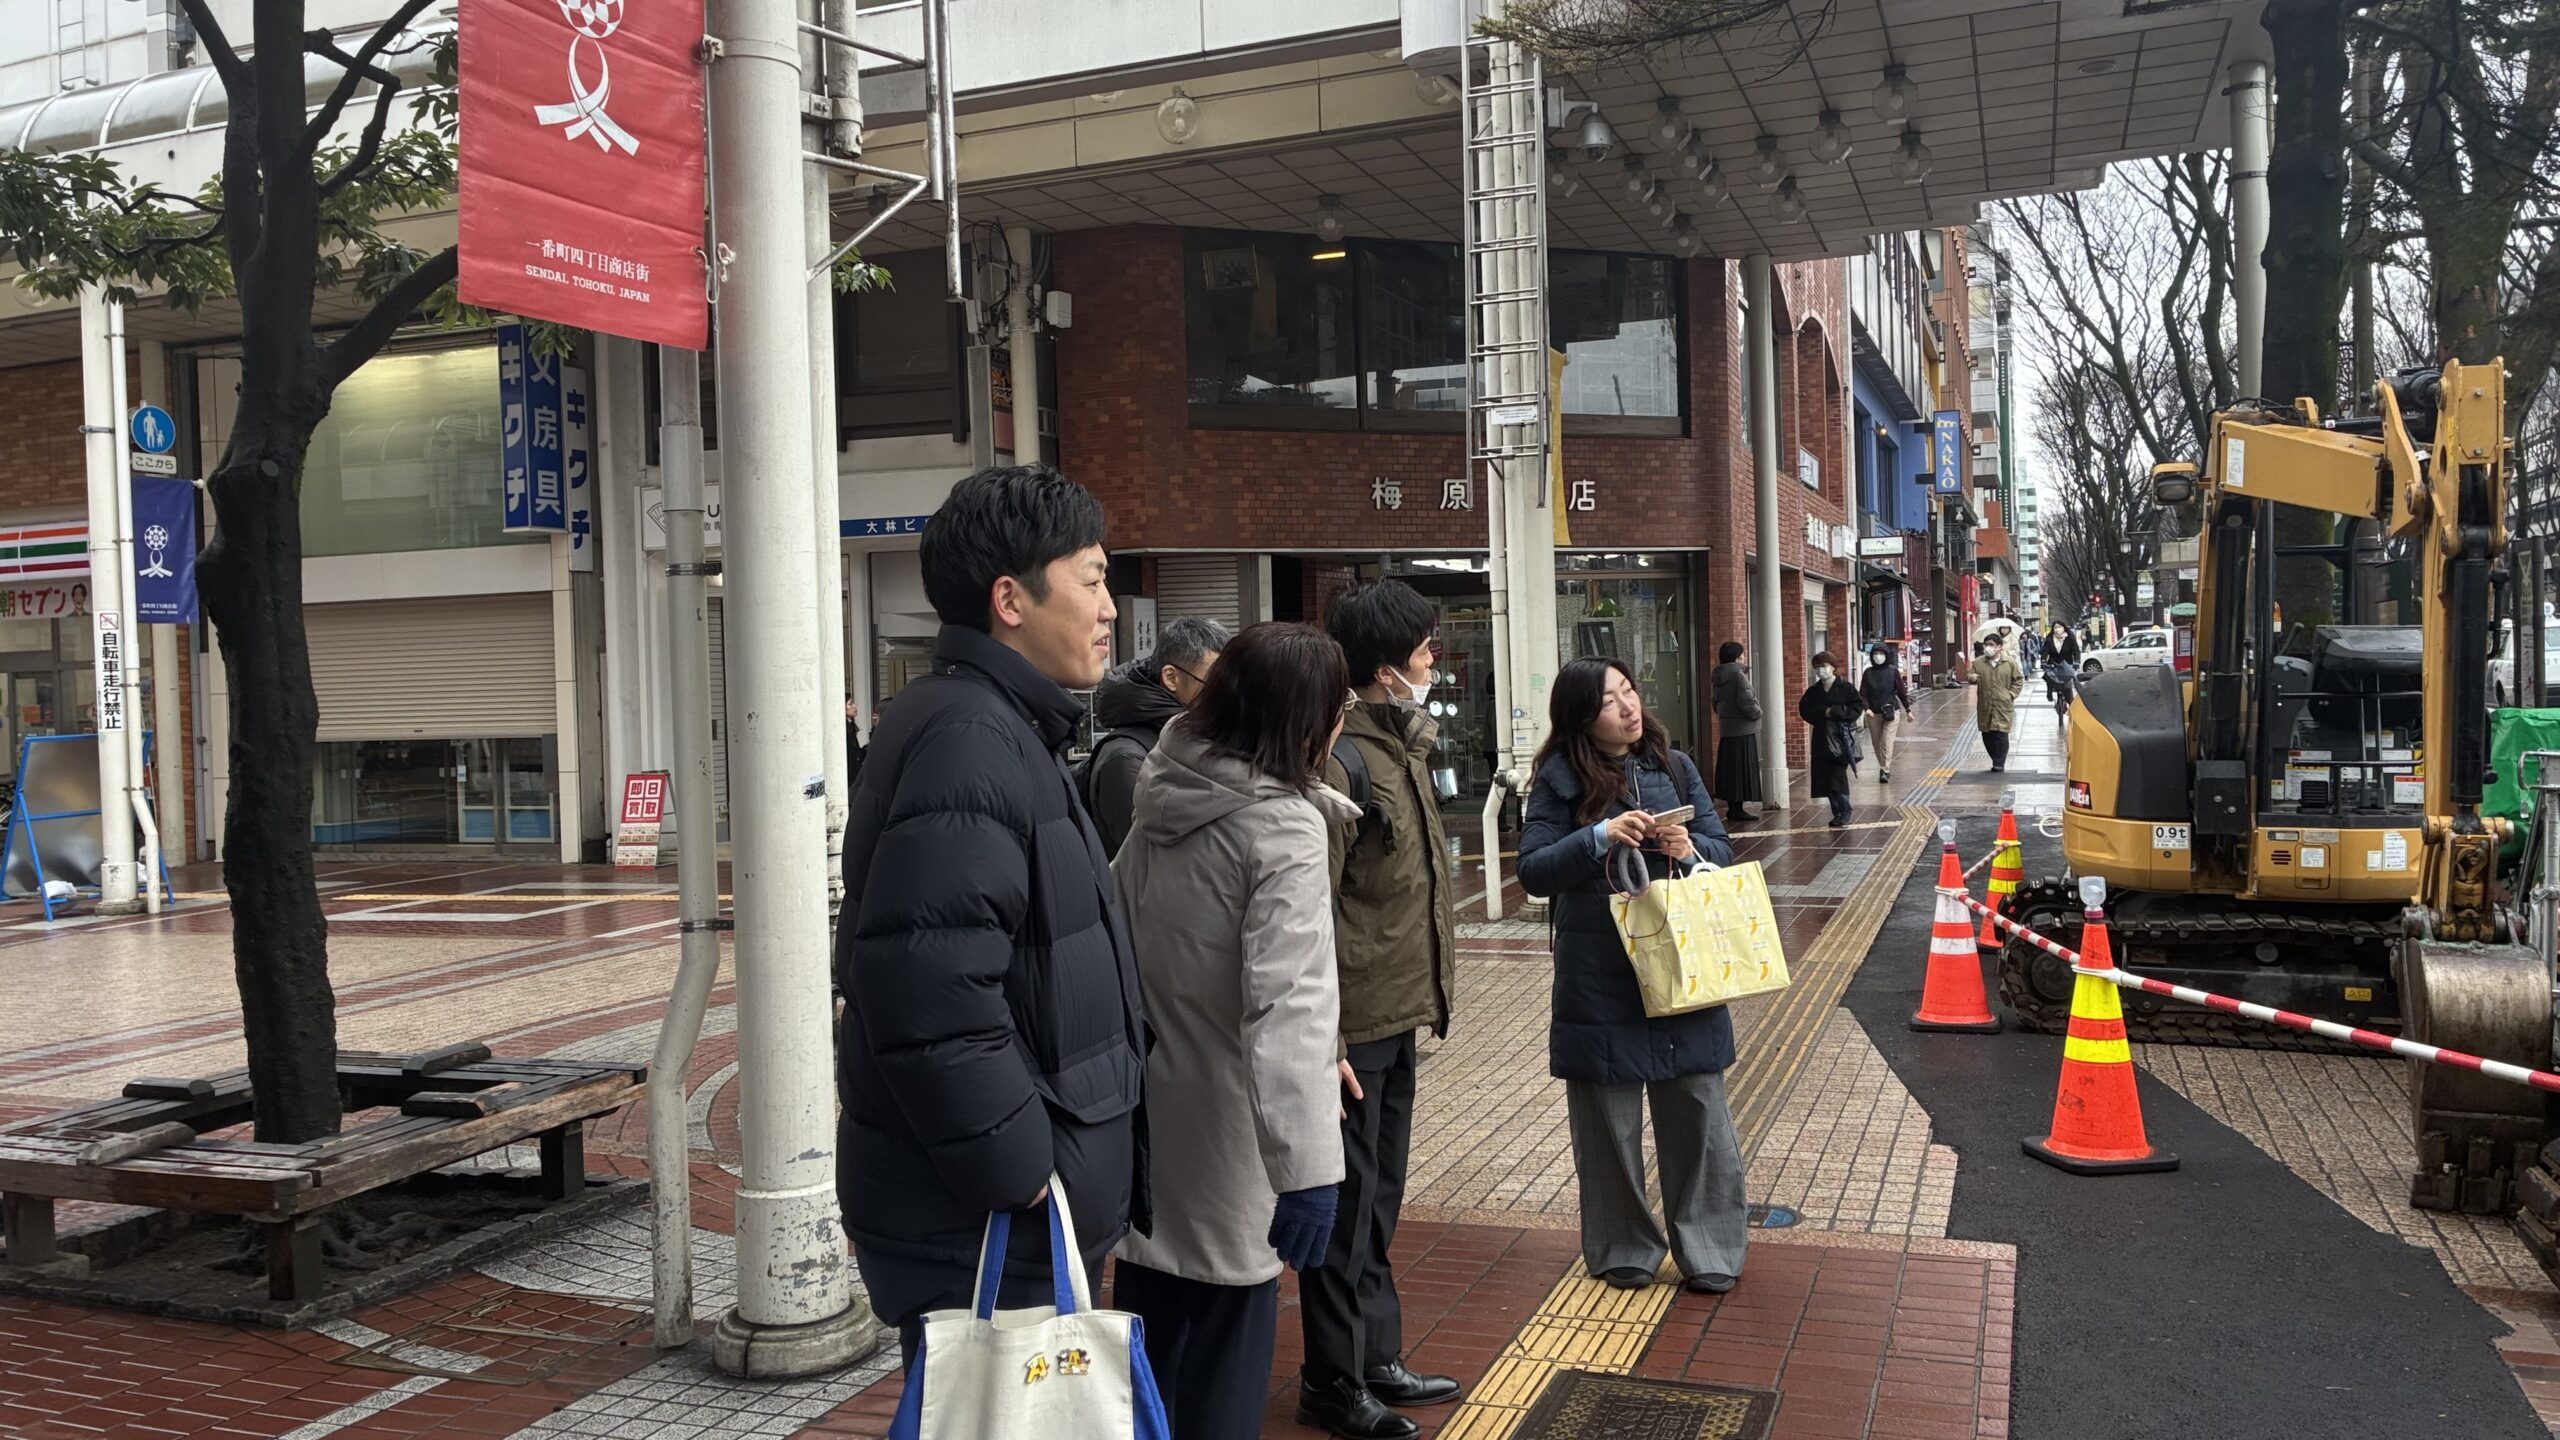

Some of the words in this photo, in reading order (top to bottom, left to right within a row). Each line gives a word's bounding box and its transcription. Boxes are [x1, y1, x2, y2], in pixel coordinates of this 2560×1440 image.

[525, 239, 650, 283] 一番町四丁目商店街
[618, 287, 650, 303] JAPAN
[501, 341, 526, 513] キクチ
[136, 456, 174, 470] ここから
[567, 389, 590, 550] キクチ
[1941, 431, 1955, 489] NAKAO
[1371, 476, 1595, 511] 梅原店
[866, 519, 928, 534] 大林ビ
[102, 632, 121, 730] 自転車走行禁止
[630, 782, 659, 796] 即日
[628, 801, 658, 815] 買取
[2155, 826, 2187, 839] 0.9t
